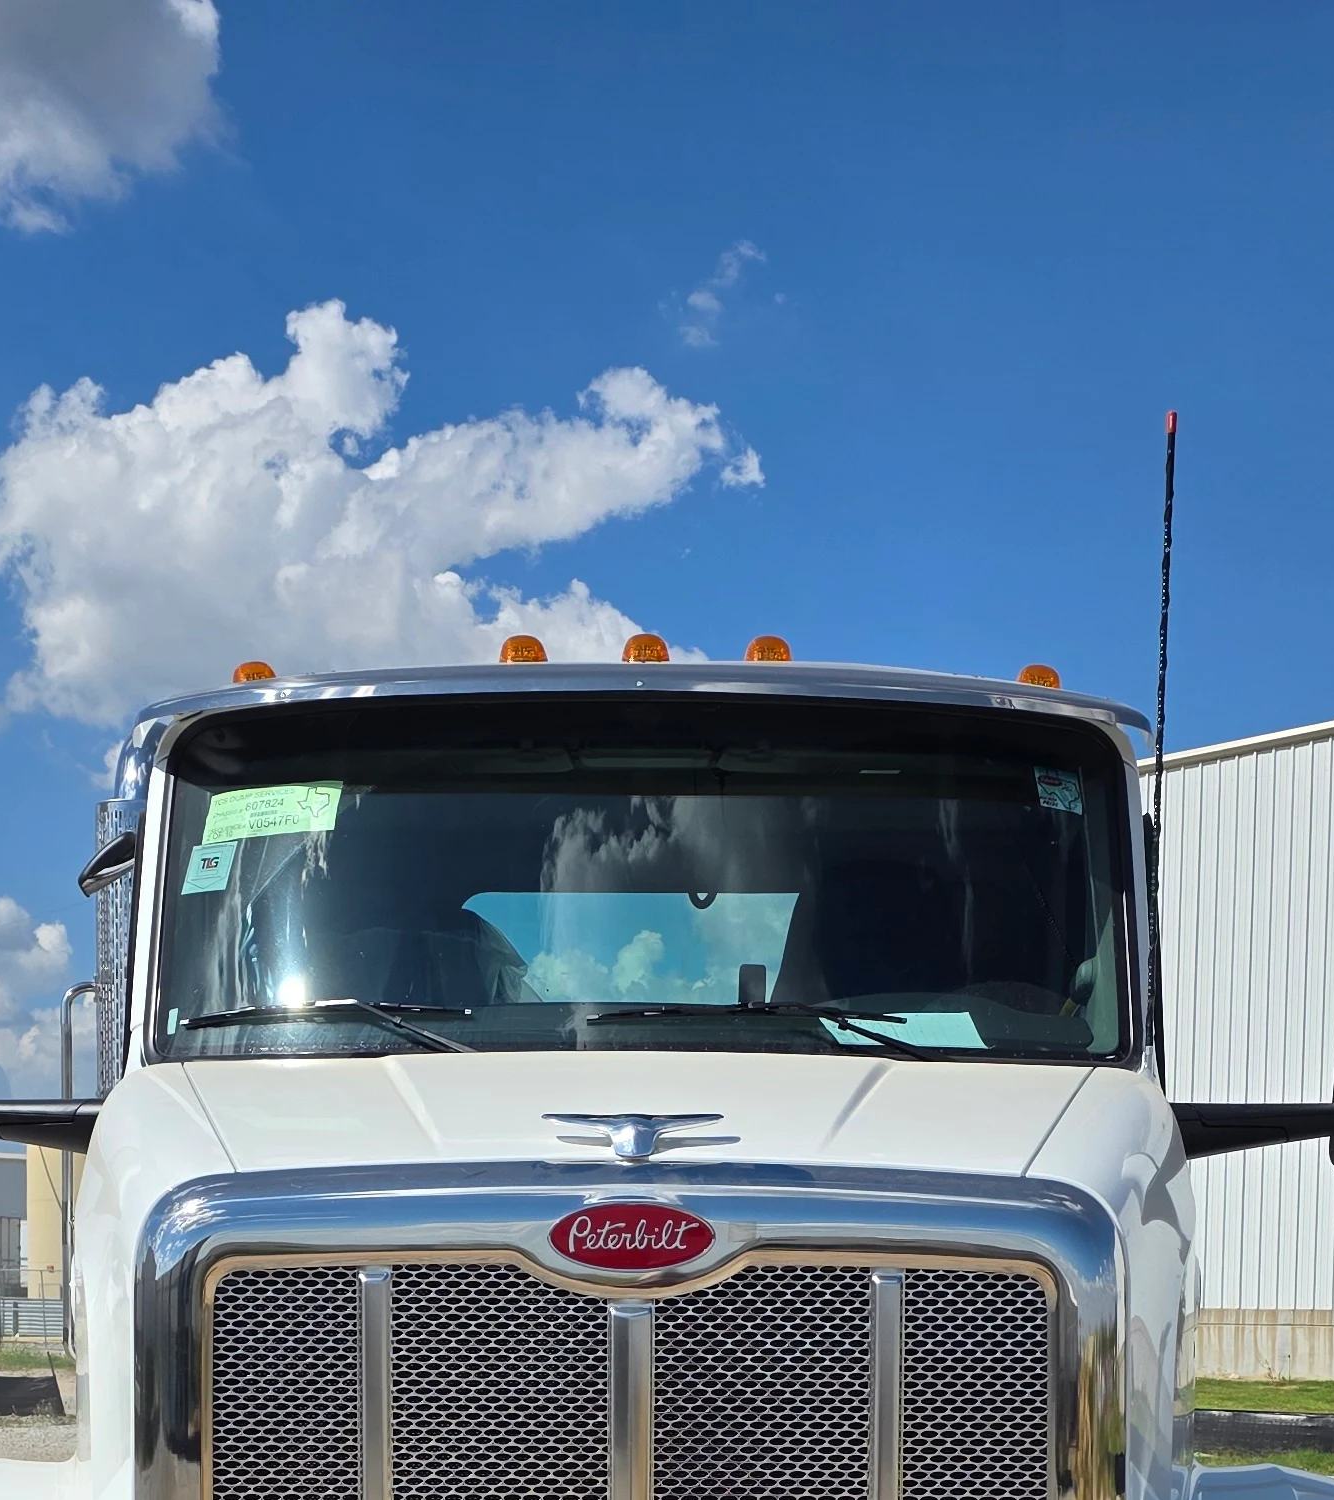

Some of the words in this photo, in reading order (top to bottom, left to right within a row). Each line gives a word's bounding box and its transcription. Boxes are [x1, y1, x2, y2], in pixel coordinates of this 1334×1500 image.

[255, 788, 296, 799] SERVICES
[200, 856, 220, 870] TLG
[569, 1215, 700, 1253] Peterbilt
